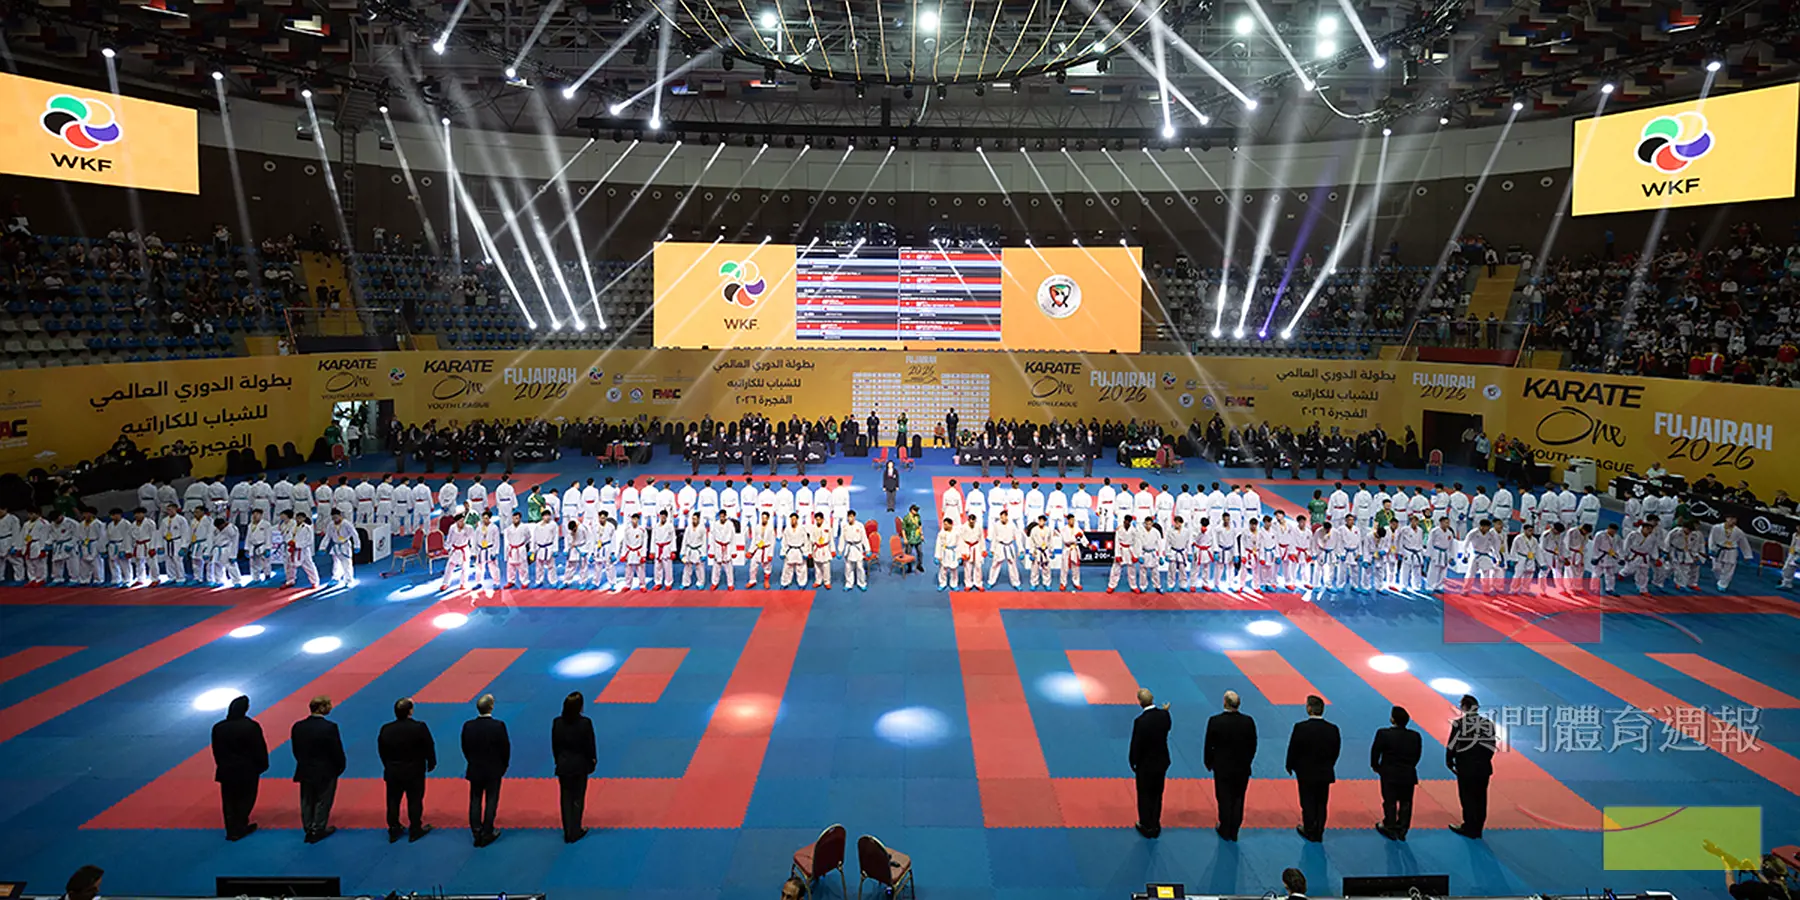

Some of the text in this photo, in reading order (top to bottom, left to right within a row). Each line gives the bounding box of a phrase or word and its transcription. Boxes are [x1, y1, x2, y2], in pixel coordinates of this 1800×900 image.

[51, 153, 112, 172] WKF
[1641, 178, 1700, 197] WKF
[318, 358, 378, 371] KARATE
[423, 359, 494, 373] KARATE
[1024, 361, 1081, 374] KARATE
[503, 367, 577, 385] FUJAIRAH
[1089, 370, 1157, 388] FUJAIRAH
[1412, 372, 1476, 389] FUJAIRAH
[89, 373, 293, 412] بطولة الدوري العالمي
[432, 375, 485, 400] One
[514, 381, 568, 401] 2026
[1098, 384, 1149, 403] 2026
[1420, 384, 1467, 401] 2026
[1523, 377, 1645, 408] KARATE
[203, 405, 268, 428] للشباب
[1536, 406, 1627, 447] One
[1654, 411, 1773, 450] FUJAIRAH
[1667, 436, 1755, 470] 2026
[1576, 456, 1635, 473] AGUE
